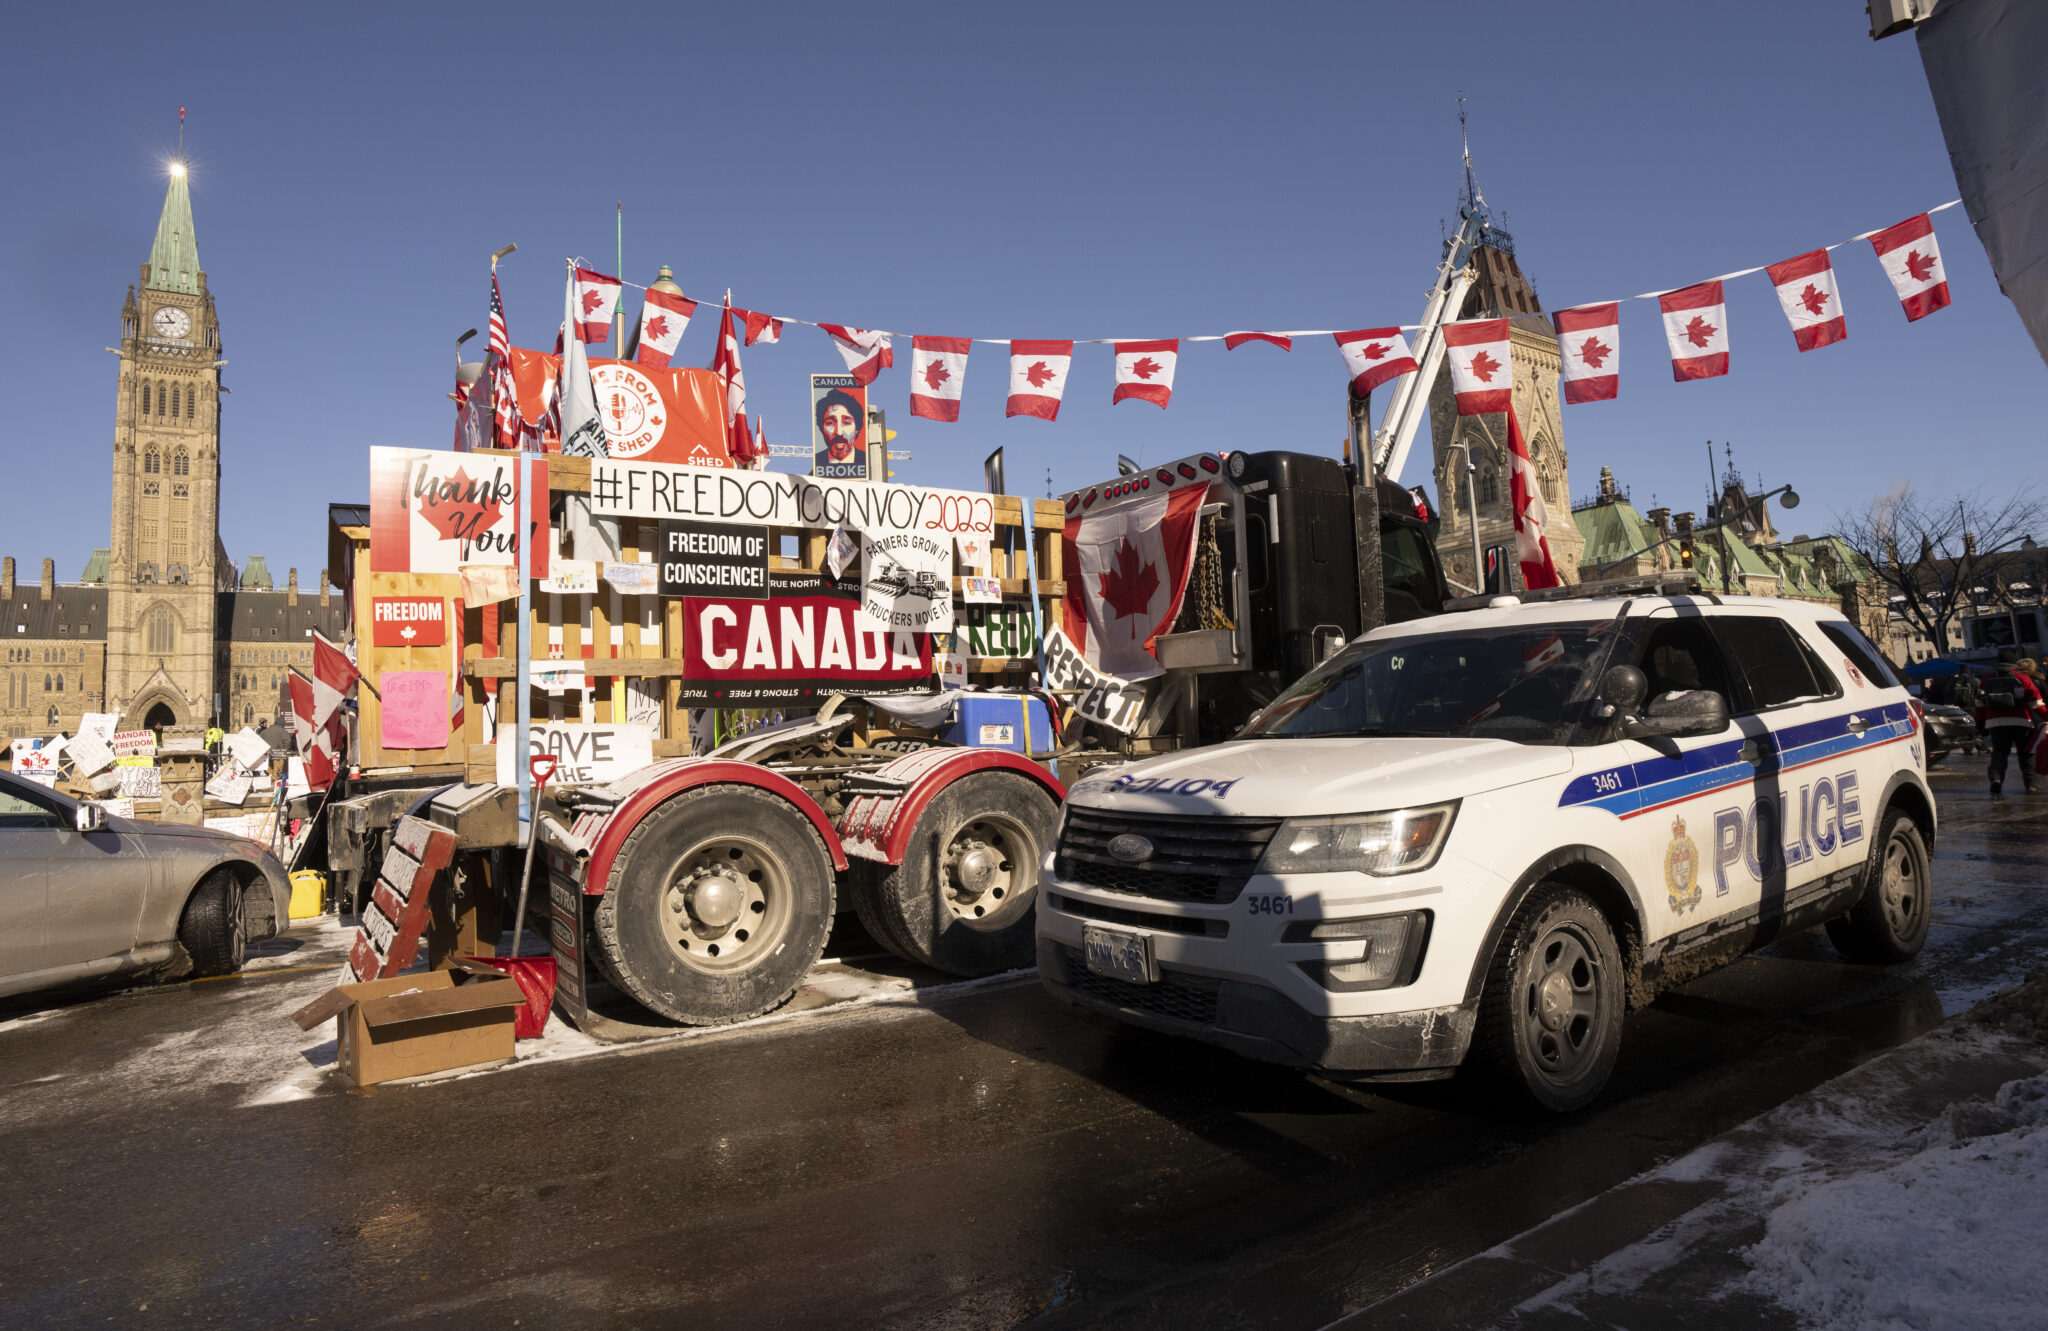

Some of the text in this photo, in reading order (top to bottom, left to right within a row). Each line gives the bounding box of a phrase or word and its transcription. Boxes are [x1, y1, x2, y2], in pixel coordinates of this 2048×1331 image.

[813, 378, 854, 386] CANADA
[618, 432, 652, 452] SHED
[687, 456, 724, 467] SHED
[815, 465, 866, 477] BROKE
[398, 454, 520, 510] Thank
[669, 532, 765, 558] FREEDOM OF
[866, 534, 950, 561] FARMERS GROW IT
[664, 563, 765, 588] CONSCIENCE!
[770, 579, 820, 588] RUE NORTH
[838, 583, 861, 592] STRO
[375, 602, 443, 622] FREEDOM
[865, 599, 949, 627] TRUCKERS MOVE IT
[700, 604, 922, 672] CANADA
[683, 689, 708, 698] TRUE
[729, 688, 799, 698] STRONG & FREE
[113, 730, 153, 740] MANDATE
[115, 739, 154, 750] FREEDOM
[545, 765, 594, 783] THE
[1591, 770, 1623, 793] 3461
[1713, 769, 1864, 898] POLICE
[1248, 895, 1294, 915] 3461
